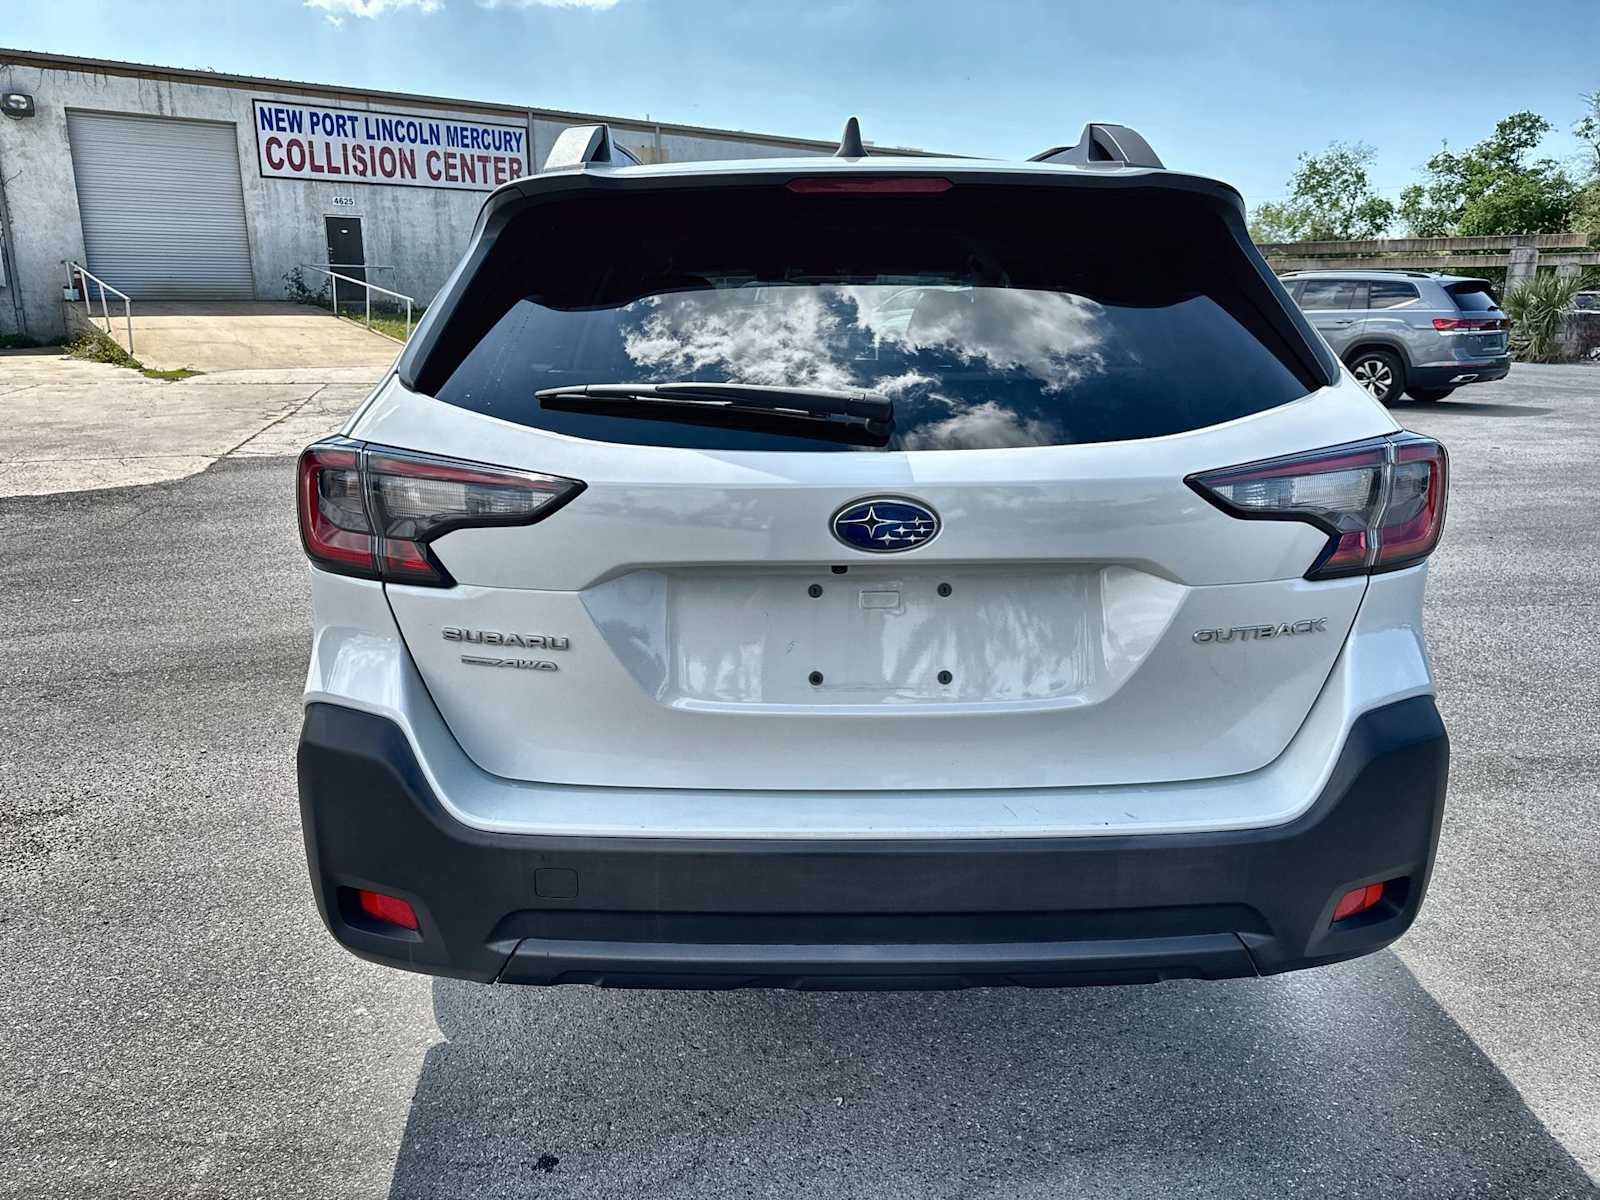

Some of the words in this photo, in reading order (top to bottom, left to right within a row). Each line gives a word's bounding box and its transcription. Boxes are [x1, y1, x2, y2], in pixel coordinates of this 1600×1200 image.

[260, 107, 303, 134] NEW
[310, 111, 358, 138] PORT
[365, 117, 441, 146] LINCOLN
[446, 125, 523, 153] MERCURY
[265, 136, 416, 179] COLLISION
[426, 150, 523, 185] CENTER
[333, 197, 354, 205] 4625
[442, 626, 570, 651] SUBARU
[1192, 617, 1328, 645] OUTBACK
[499, 658, 559, 672] AWD
